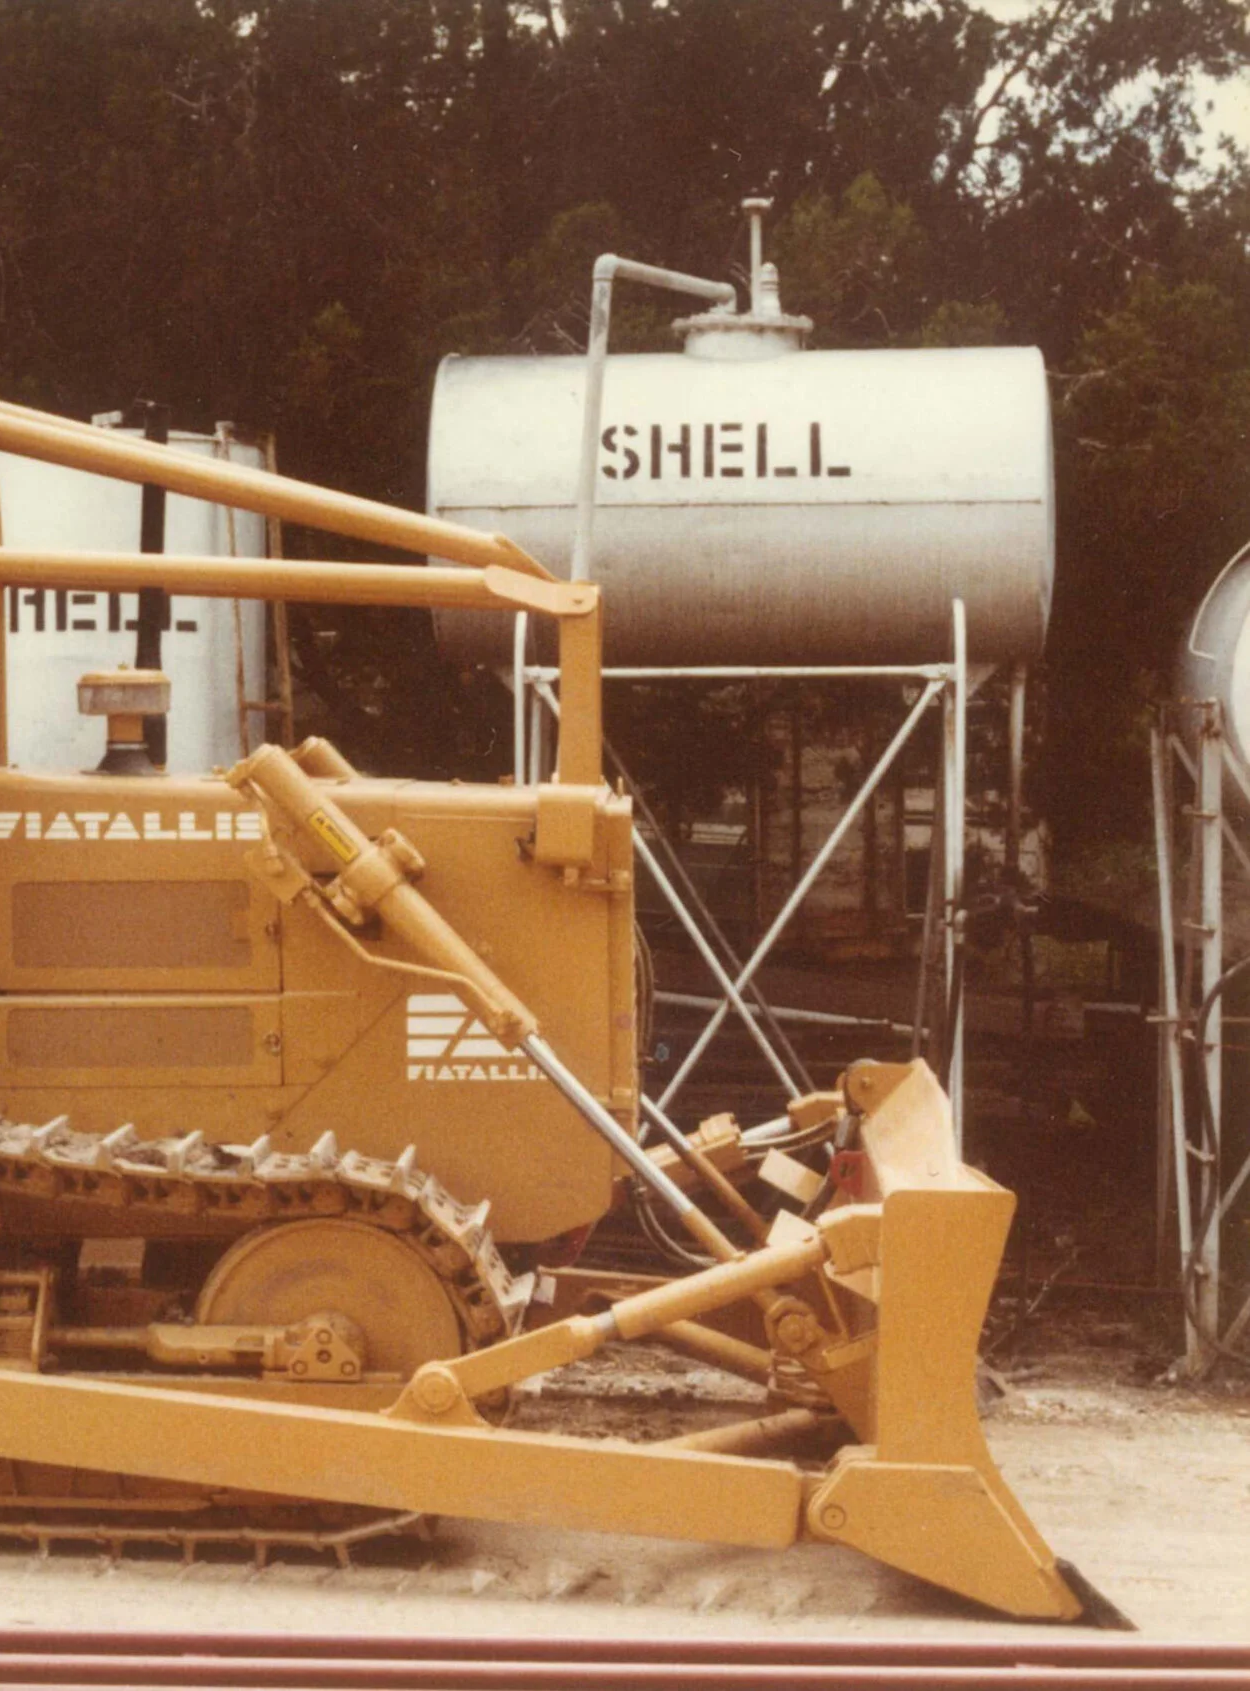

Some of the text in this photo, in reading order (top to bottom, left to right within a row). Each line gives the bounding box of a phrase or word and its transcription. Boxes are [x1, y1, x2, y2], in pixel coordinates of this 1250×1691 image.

[601, 421, 851, 480] SHELL
[8, 588, 197, 632] HELL
[407, 1064, 548, 1081] FIATALLI
